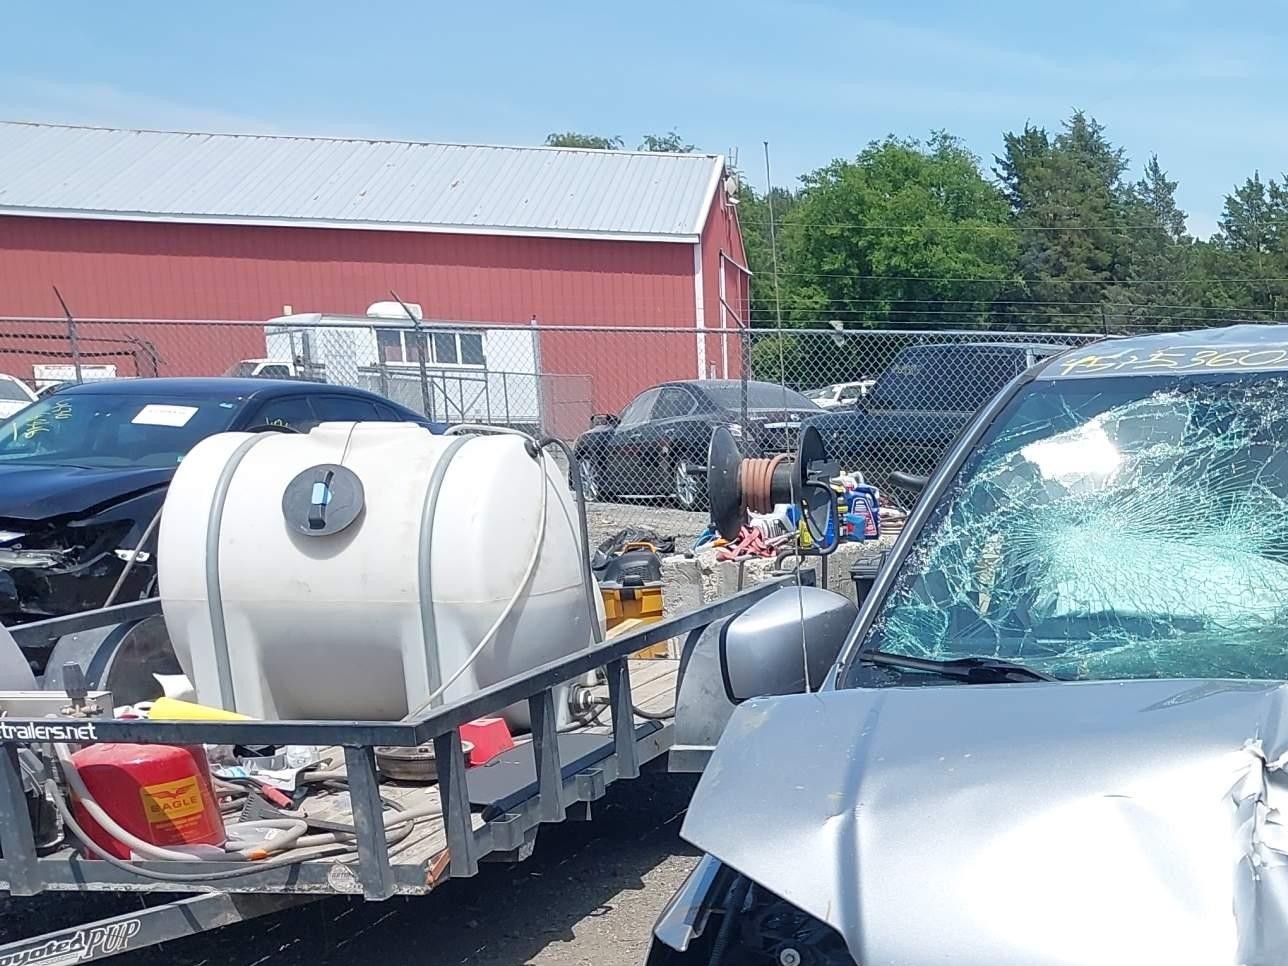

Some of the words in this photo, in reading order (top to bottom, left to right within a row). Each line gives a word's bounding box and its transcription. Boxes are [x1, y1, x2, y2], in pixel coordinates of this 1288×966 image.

[0, 721, 98, 740] trailers.net
[150, 795, 198, 813] EAGLE
[82, 919, 141, 960] PUP
